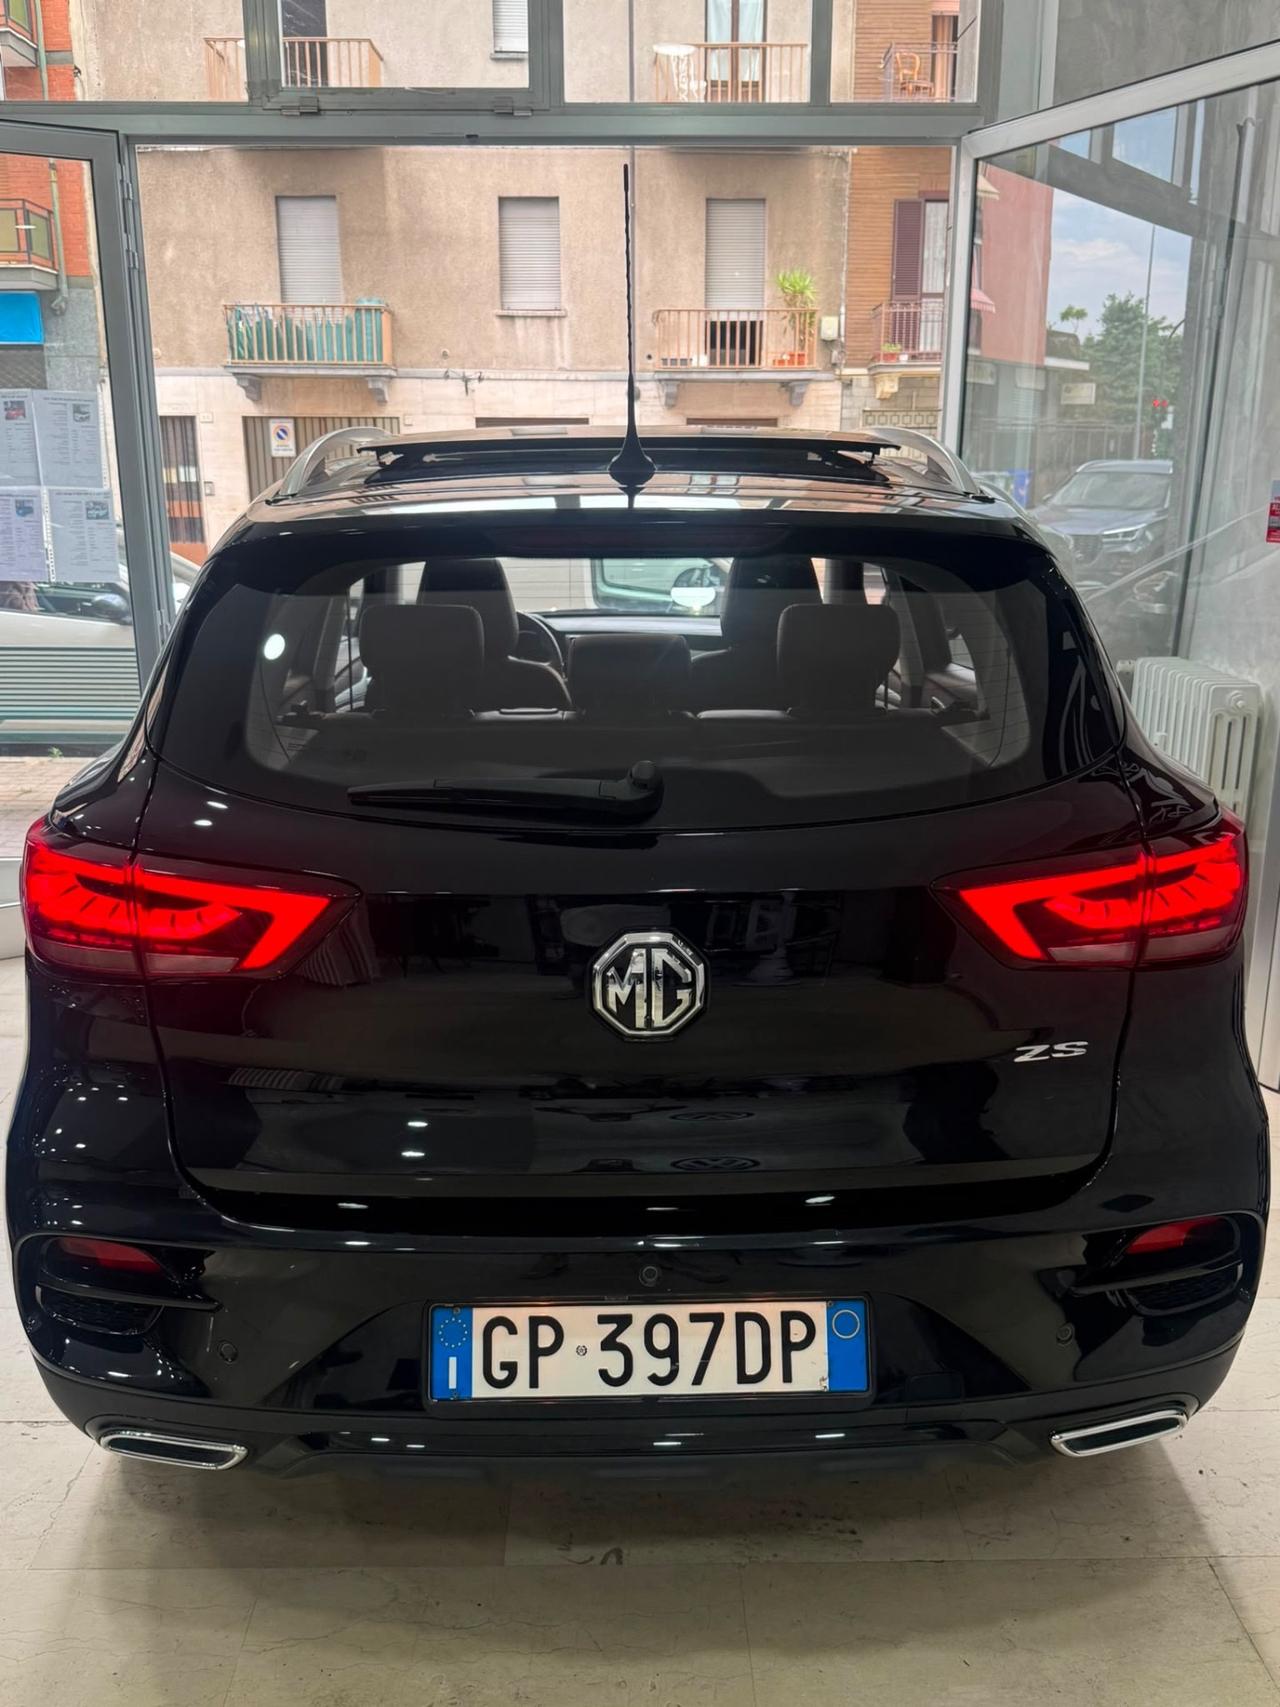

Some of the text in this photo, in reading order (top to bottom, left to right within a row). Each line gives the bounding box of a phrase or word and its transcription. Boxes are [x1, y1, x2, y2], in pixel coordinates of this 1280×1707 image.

[605, 948, 692, 1029] MG
[1013, 1041, 1089, 1063] ZS
[481, 1310, 817, 1390] GP 397DP
